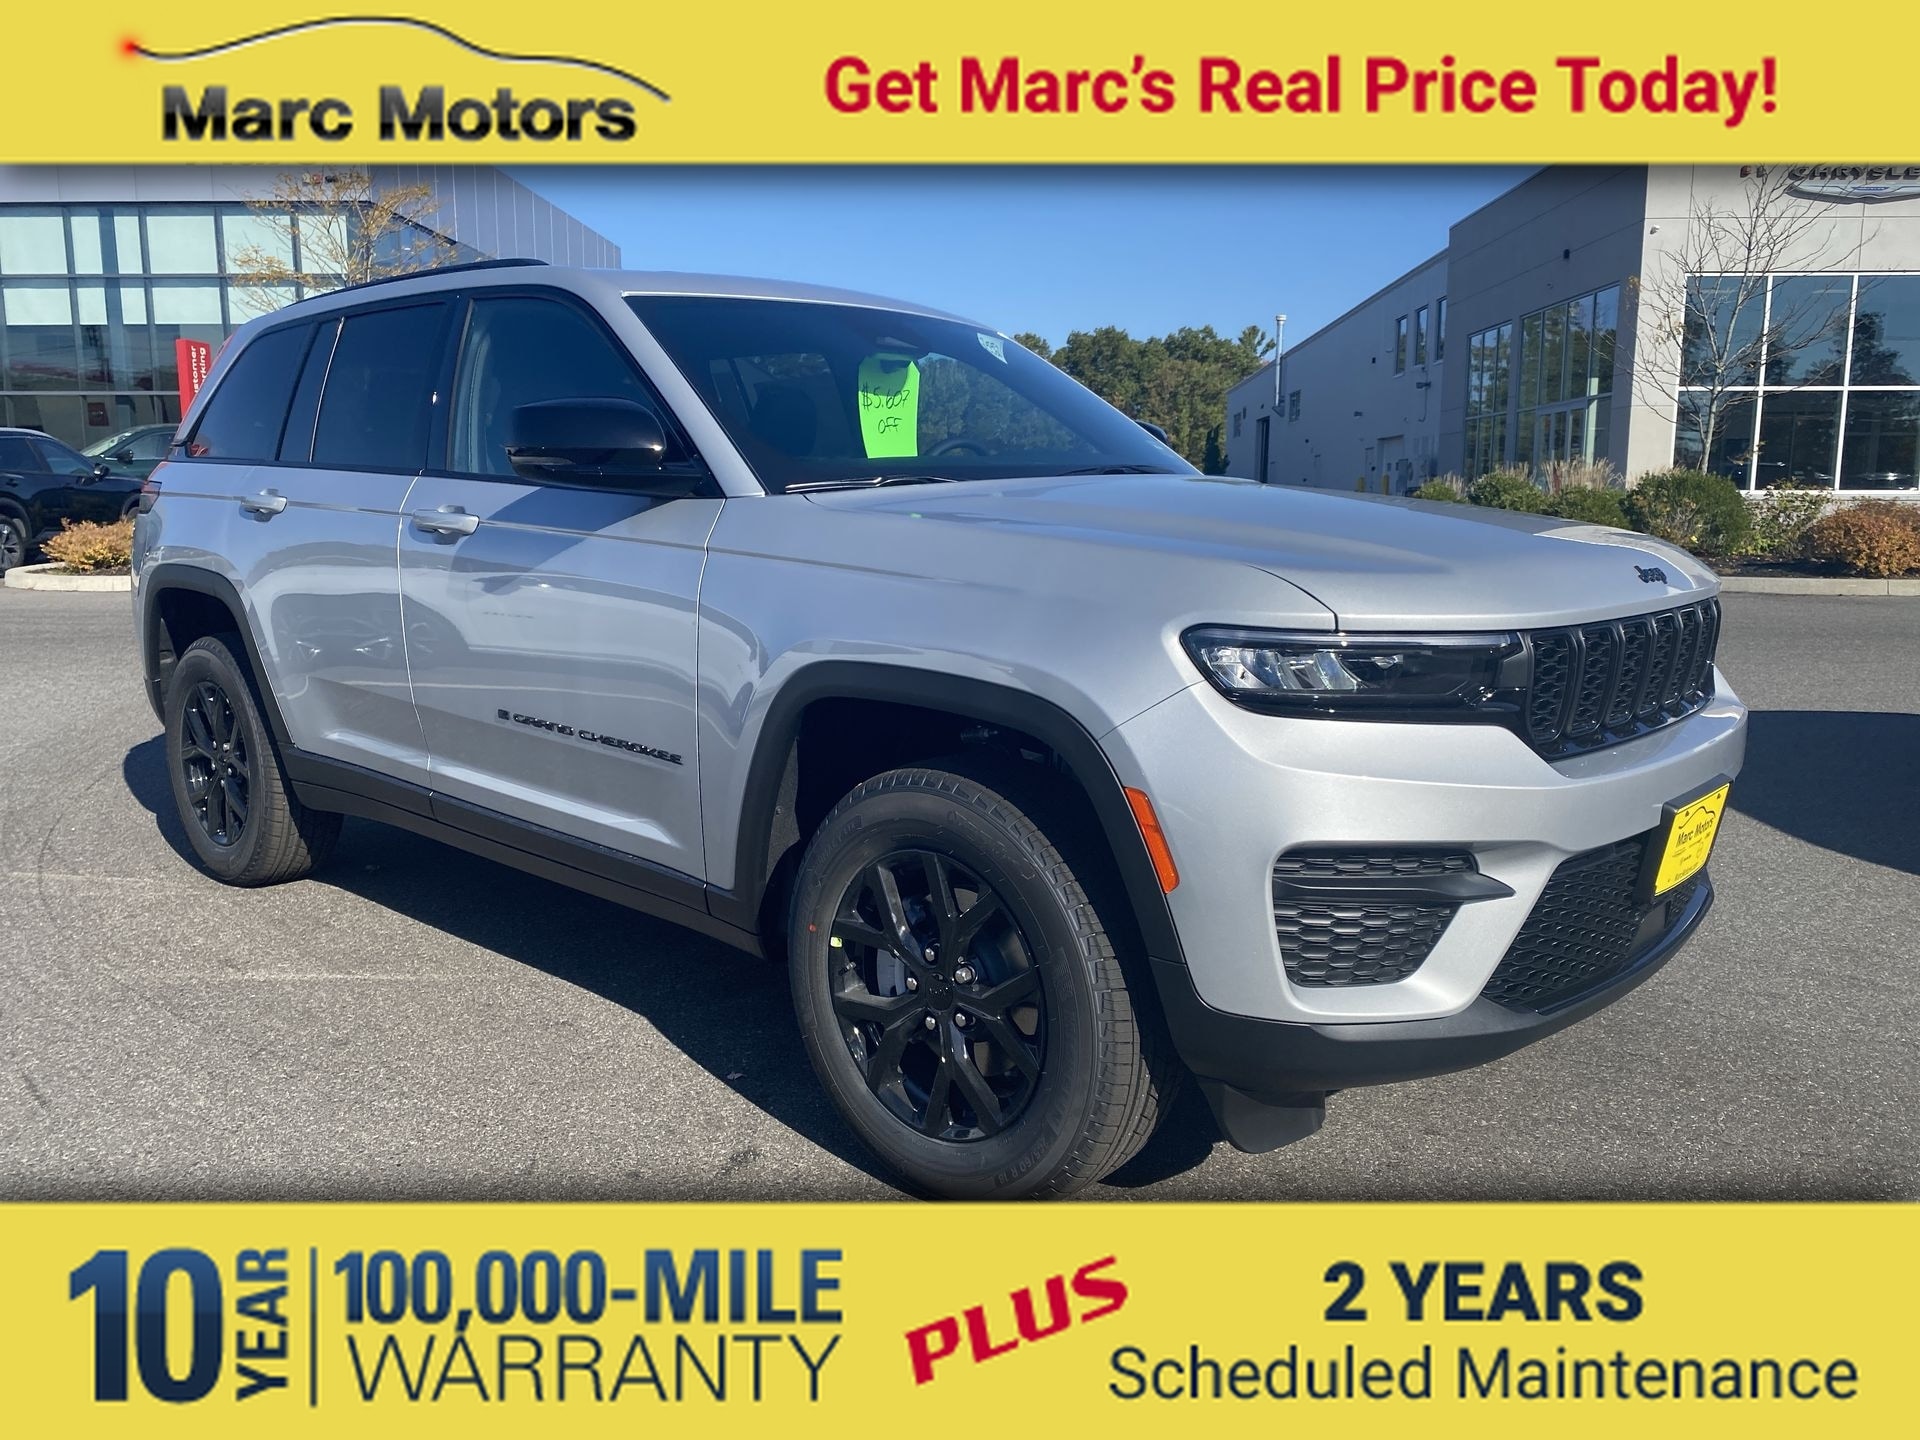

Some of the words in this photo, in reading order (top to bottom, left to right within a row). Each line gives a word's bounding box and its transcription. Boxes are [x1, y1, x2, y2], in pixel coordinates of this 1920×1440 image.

[1788, 165, 1920, 181] CHRYSLE
[878, 416, 903, 434] OFF
[513, 713, 575, 736] GRAND
[578, 729, 684, 765] CHEROKEE
[1675, 831, 1694, 848] Marc
[1694, 817, 1714, 838] Motors
